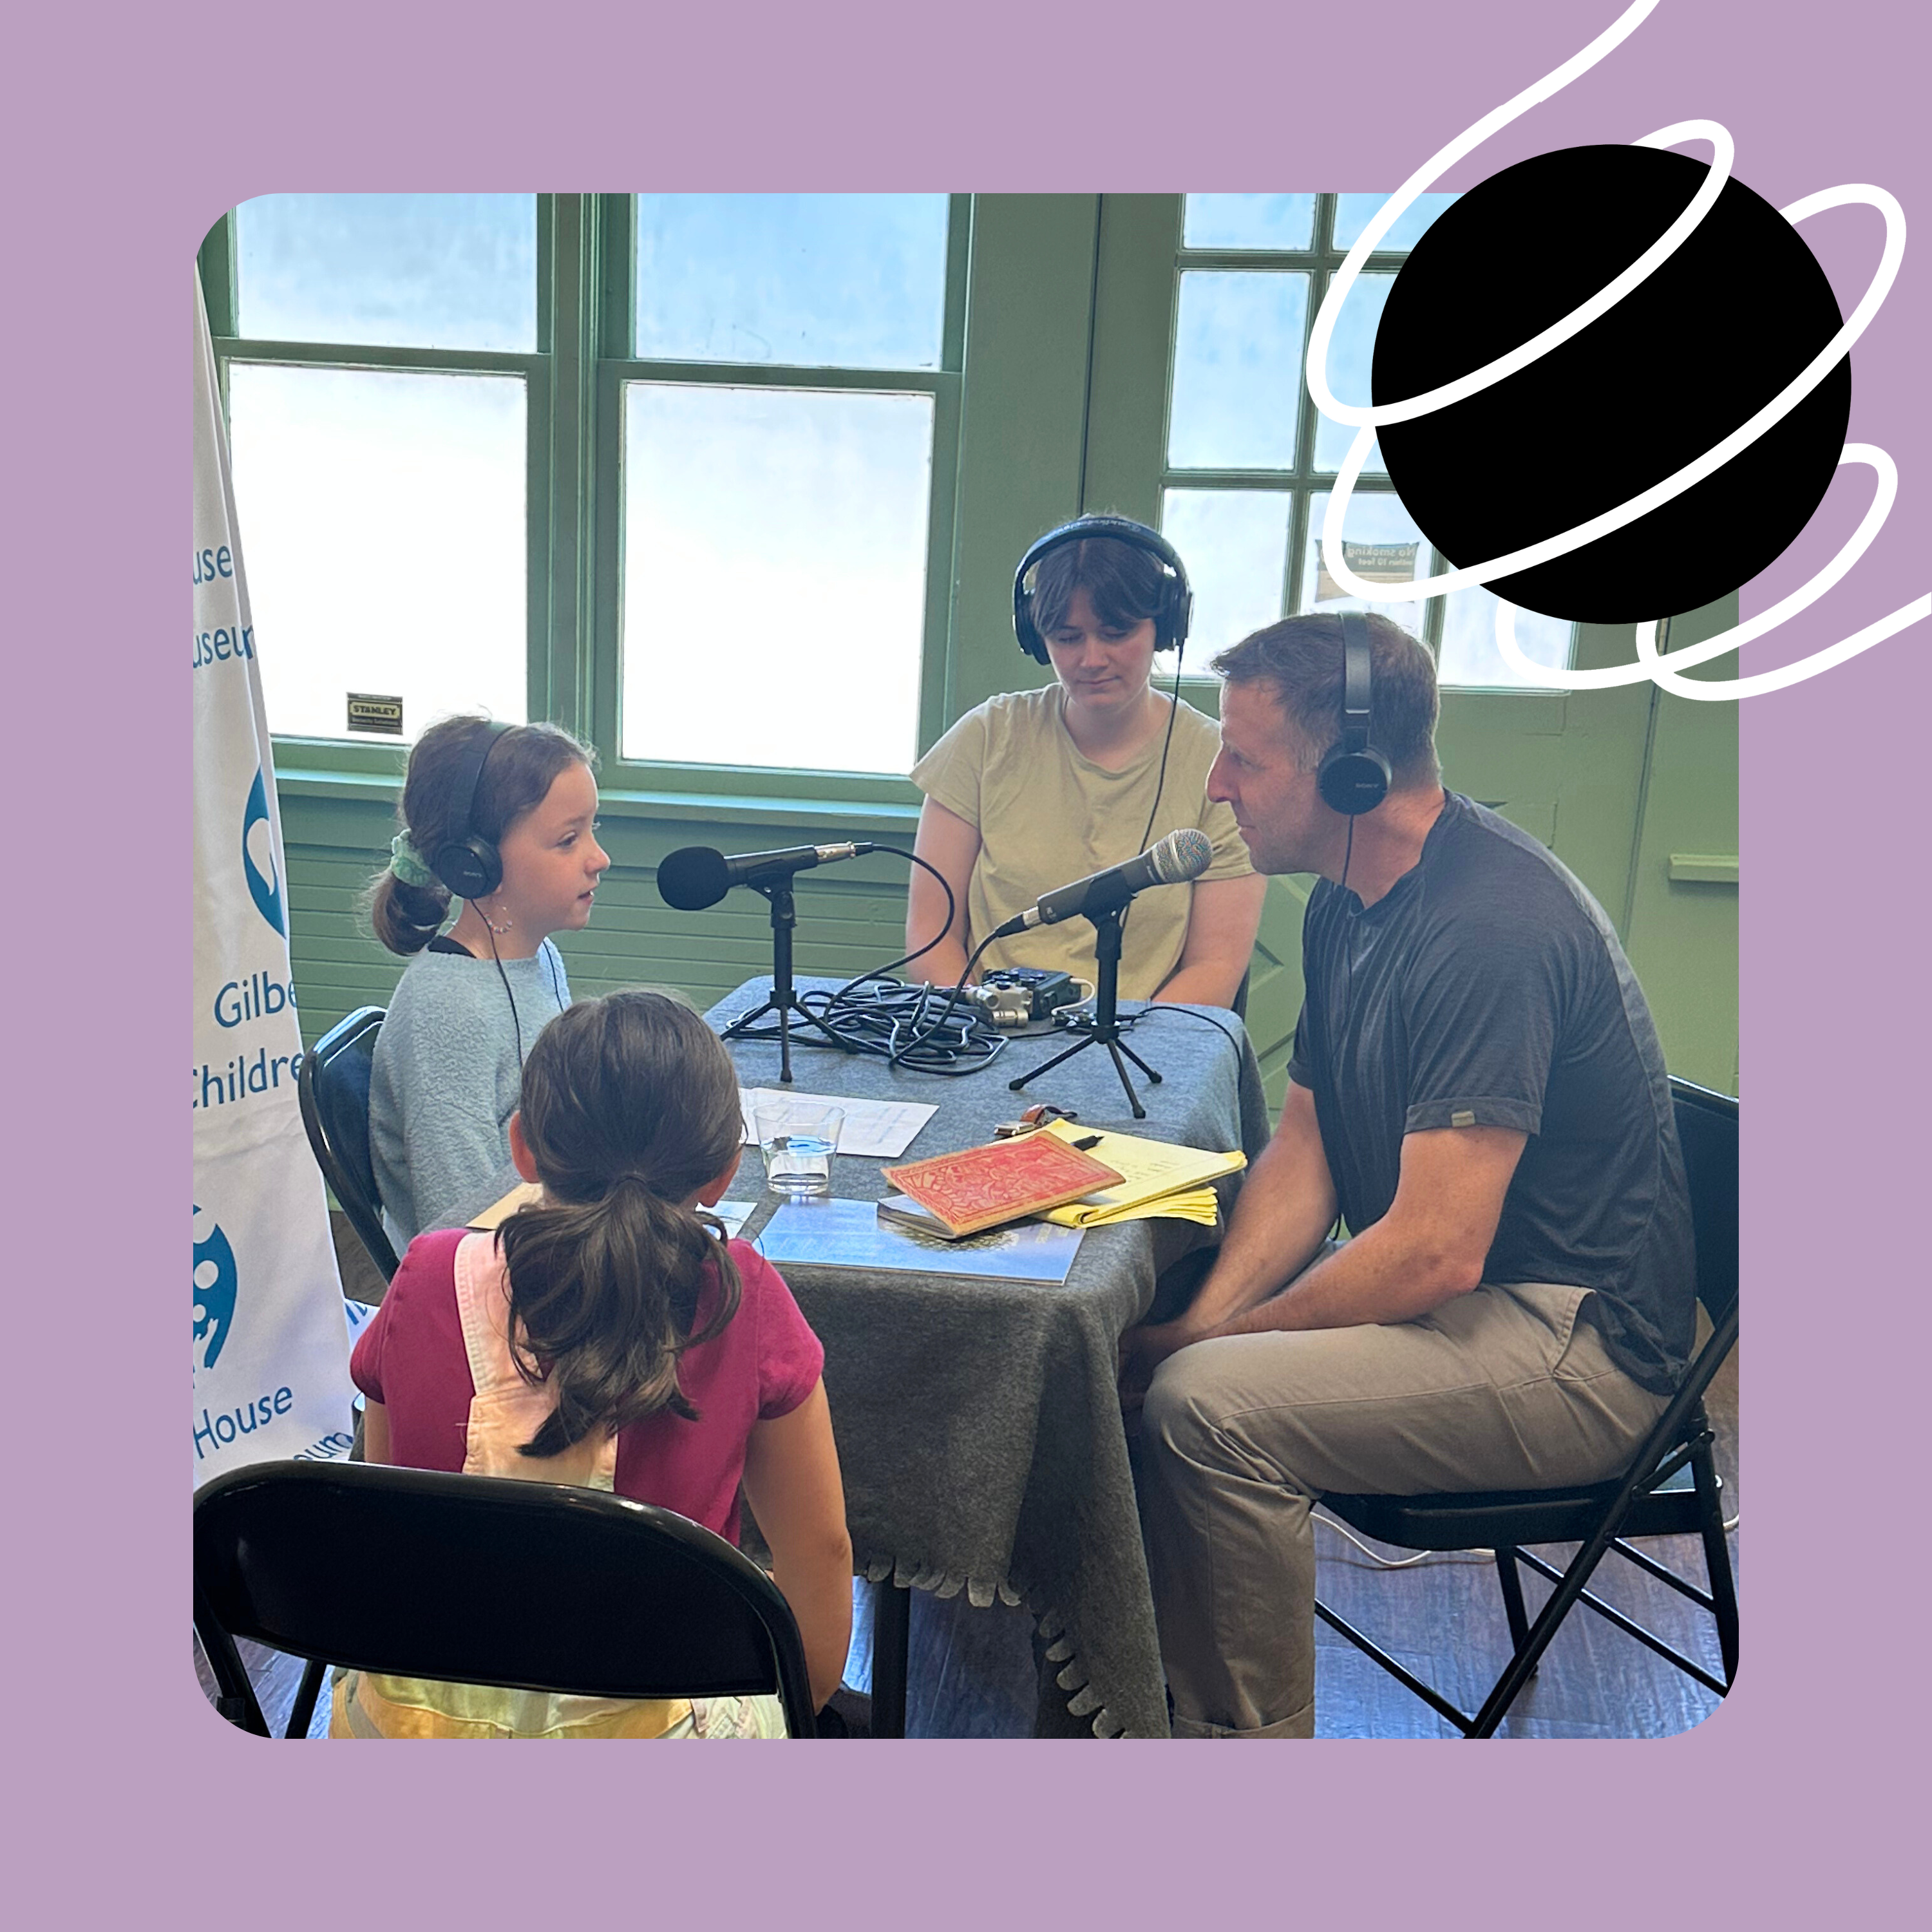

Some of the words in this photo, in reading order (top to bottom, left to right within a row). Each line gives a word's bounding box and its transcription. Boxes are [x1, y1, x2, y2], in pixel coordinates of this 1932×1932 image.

[353, 705, 396, 715] STANLEY
[193, 1048, 304, 1108] hildre
[193, 1387, 292, 1459] House
[293, 1432, 354, 1461] um
